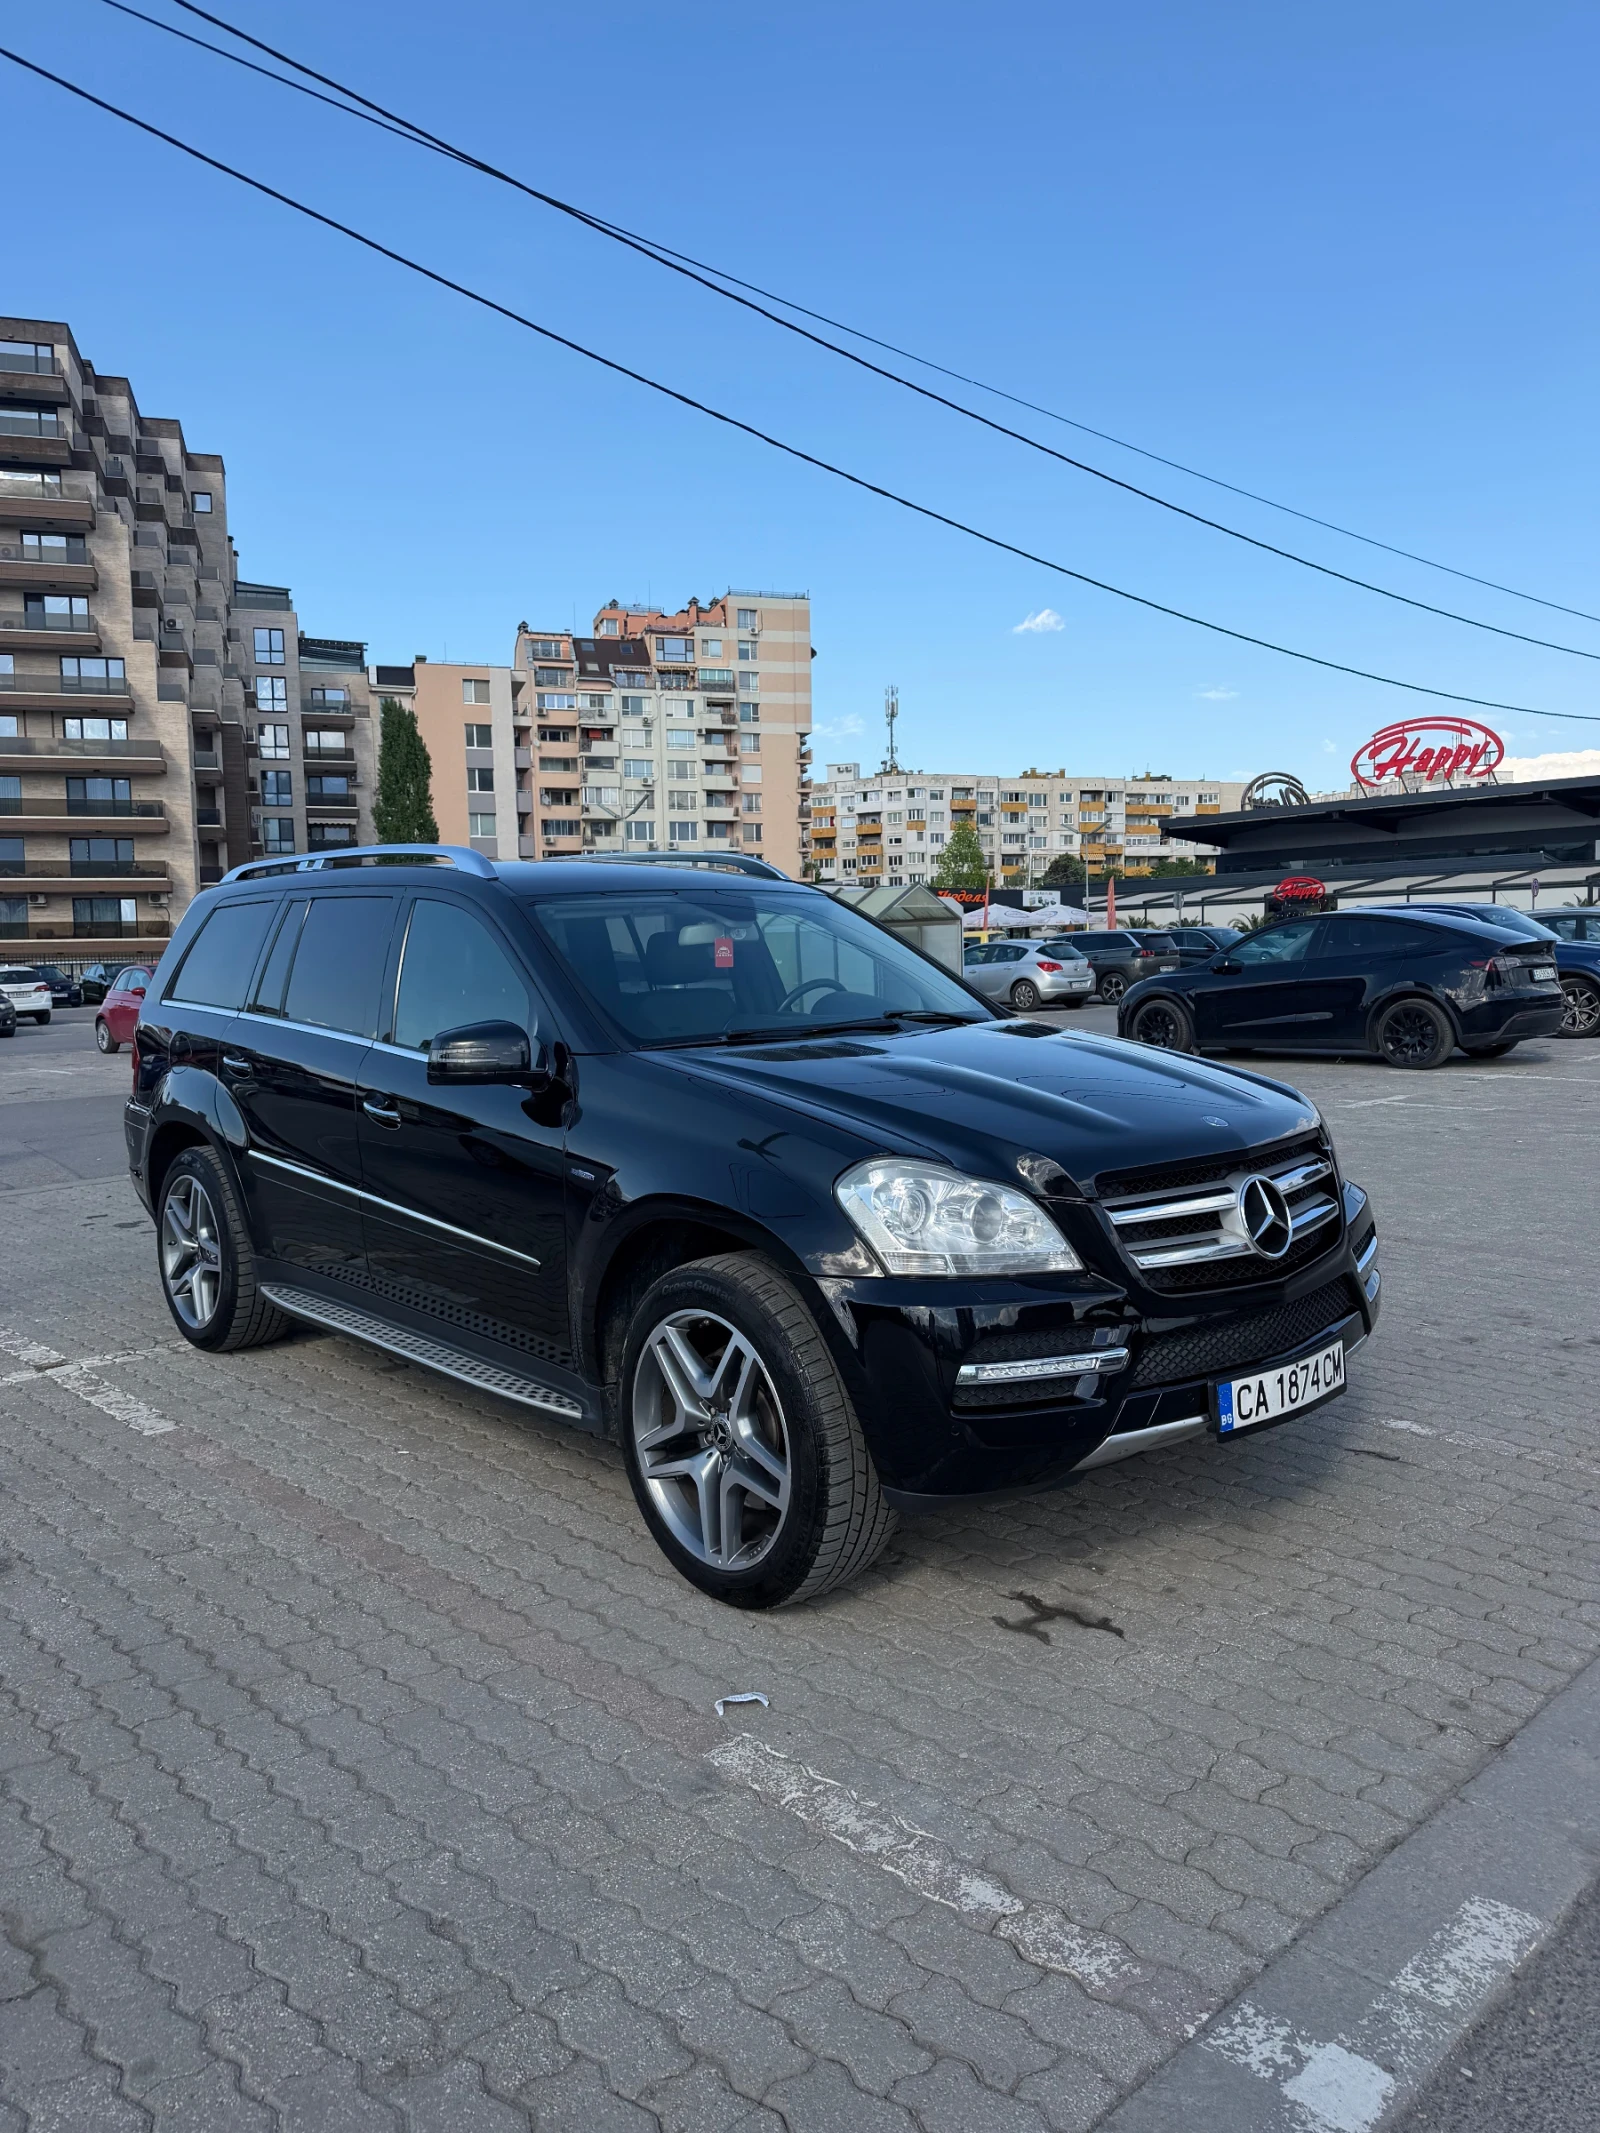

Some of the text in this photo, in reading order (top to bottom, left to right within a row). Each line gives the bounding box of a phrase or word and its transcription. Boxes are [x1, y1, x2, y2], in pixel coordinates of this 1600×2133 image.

[1367, 736, 1491, 781] Happy
[1279, 882, 1321, 900] Happy
[662, 1279, 737, 1306] CrossContac
[1237, 1347, 1342, 1420] CA 1874 CM
[1221, 1413, 1233, 1426] BG
